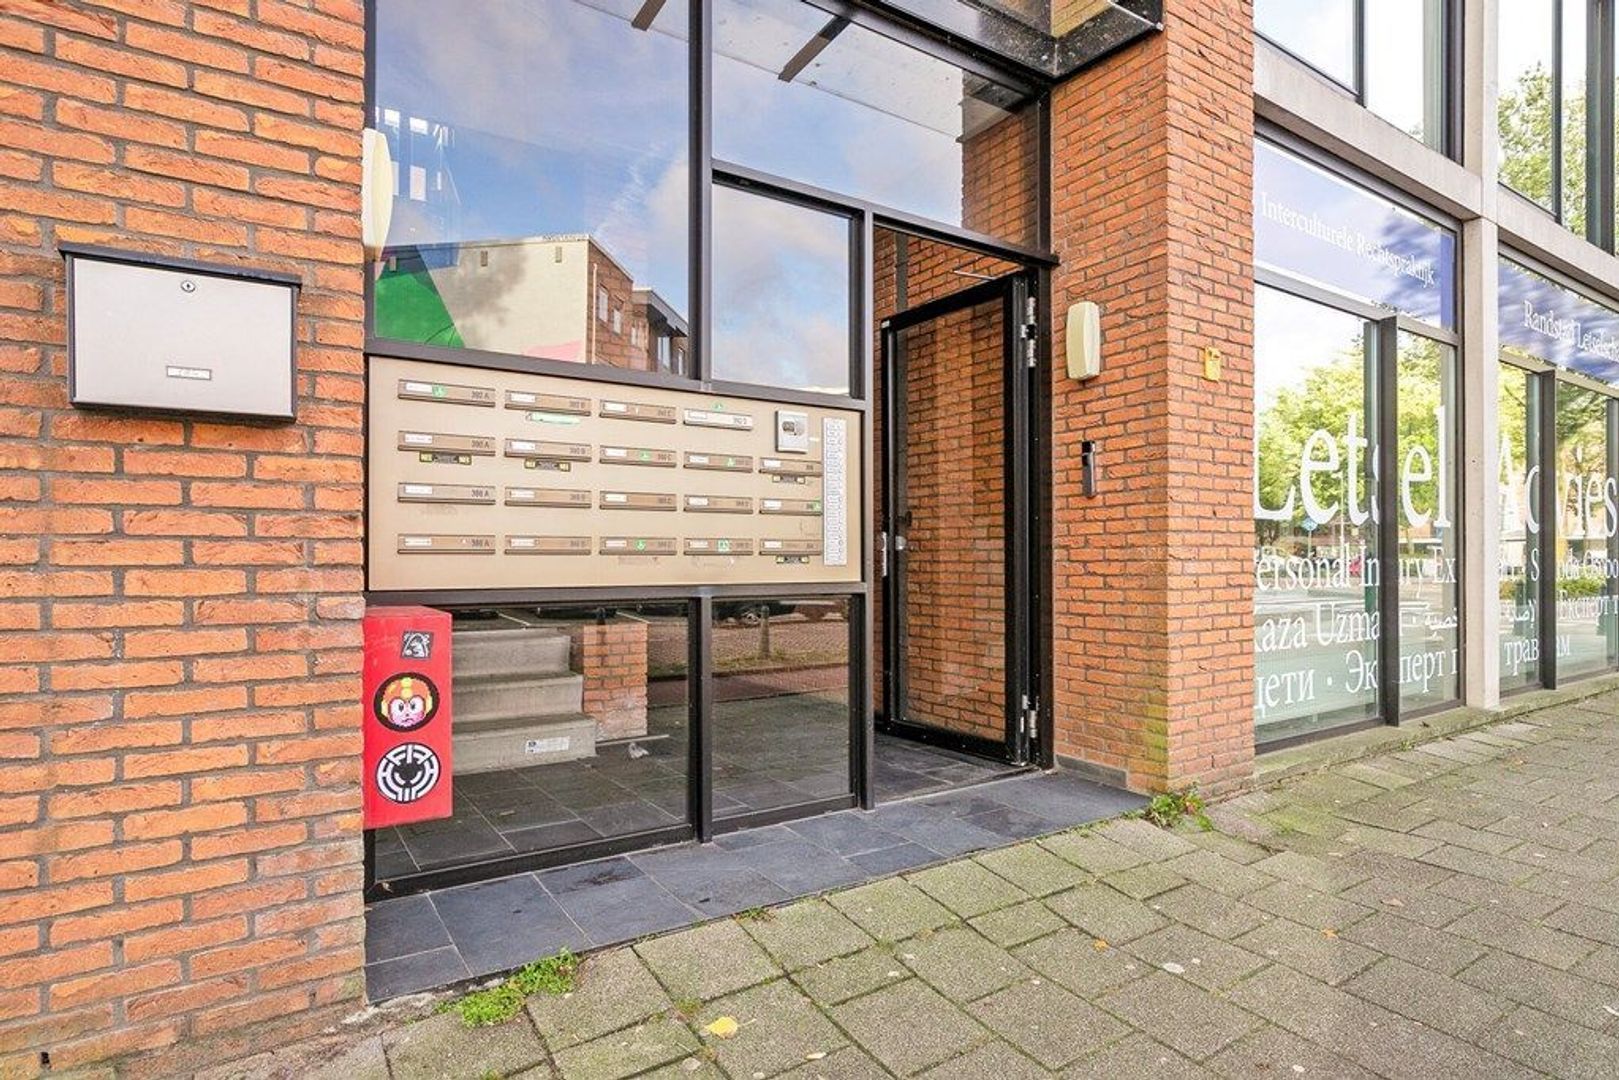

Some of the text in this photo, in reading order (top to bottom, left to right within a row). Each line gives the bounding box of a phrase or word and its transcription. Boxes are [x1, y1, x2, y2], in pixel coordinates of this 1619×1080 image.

[1262, 192, 1353, 252] Interculturele
[1253, 400, 1452, 528] Letel
[1359, 540, 1426, 598] Inry
[1254, 604, 1308, 653] aza
[1346, 648, 1447, 694] Экперт
[1503, 633, 1571, 677] травам
